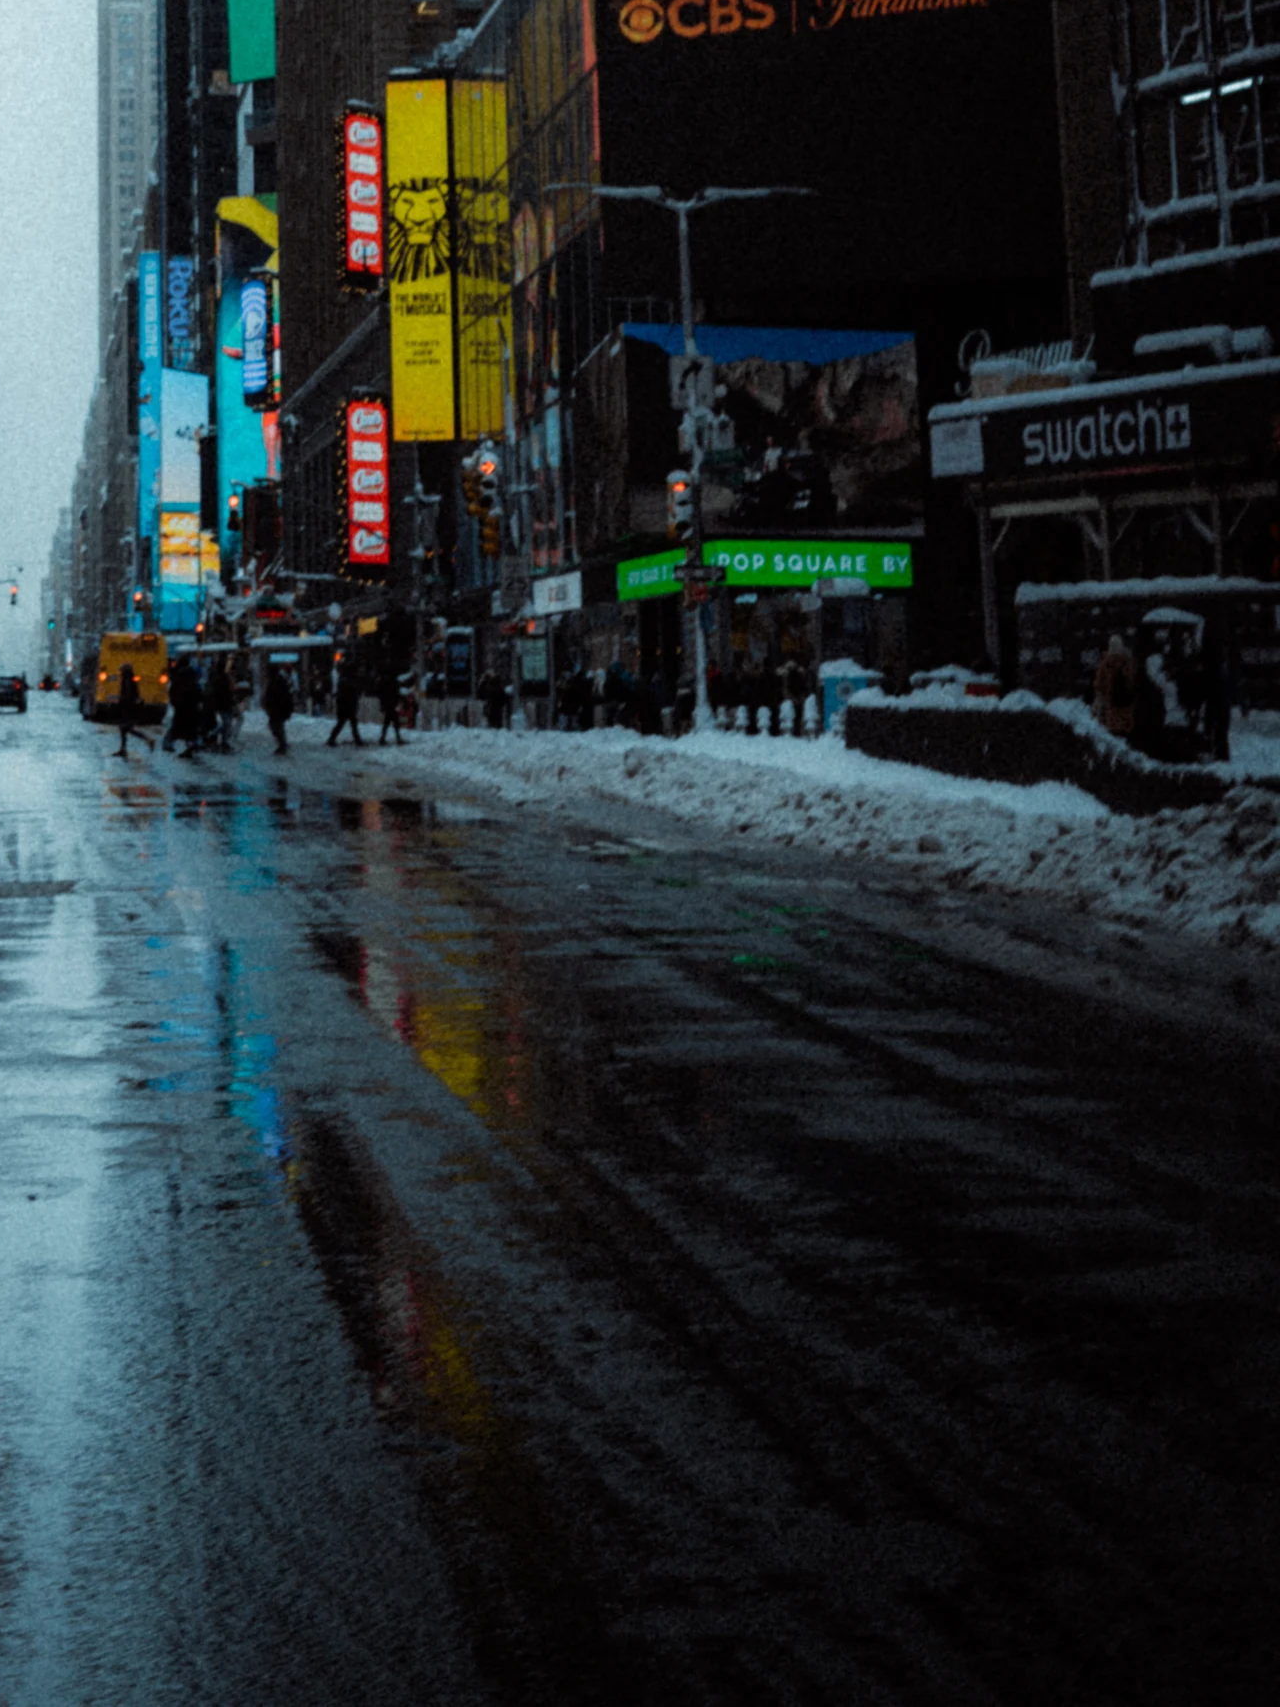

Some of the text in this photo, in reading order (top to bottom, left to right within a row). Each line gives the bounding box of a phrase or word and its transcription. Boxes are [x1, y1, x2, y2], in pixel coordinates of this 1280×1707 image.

[1022, 403, 1163, 466] swatch
[773, 553, 868, 574] SQUARE
[882, 553, 909, 575] BY
